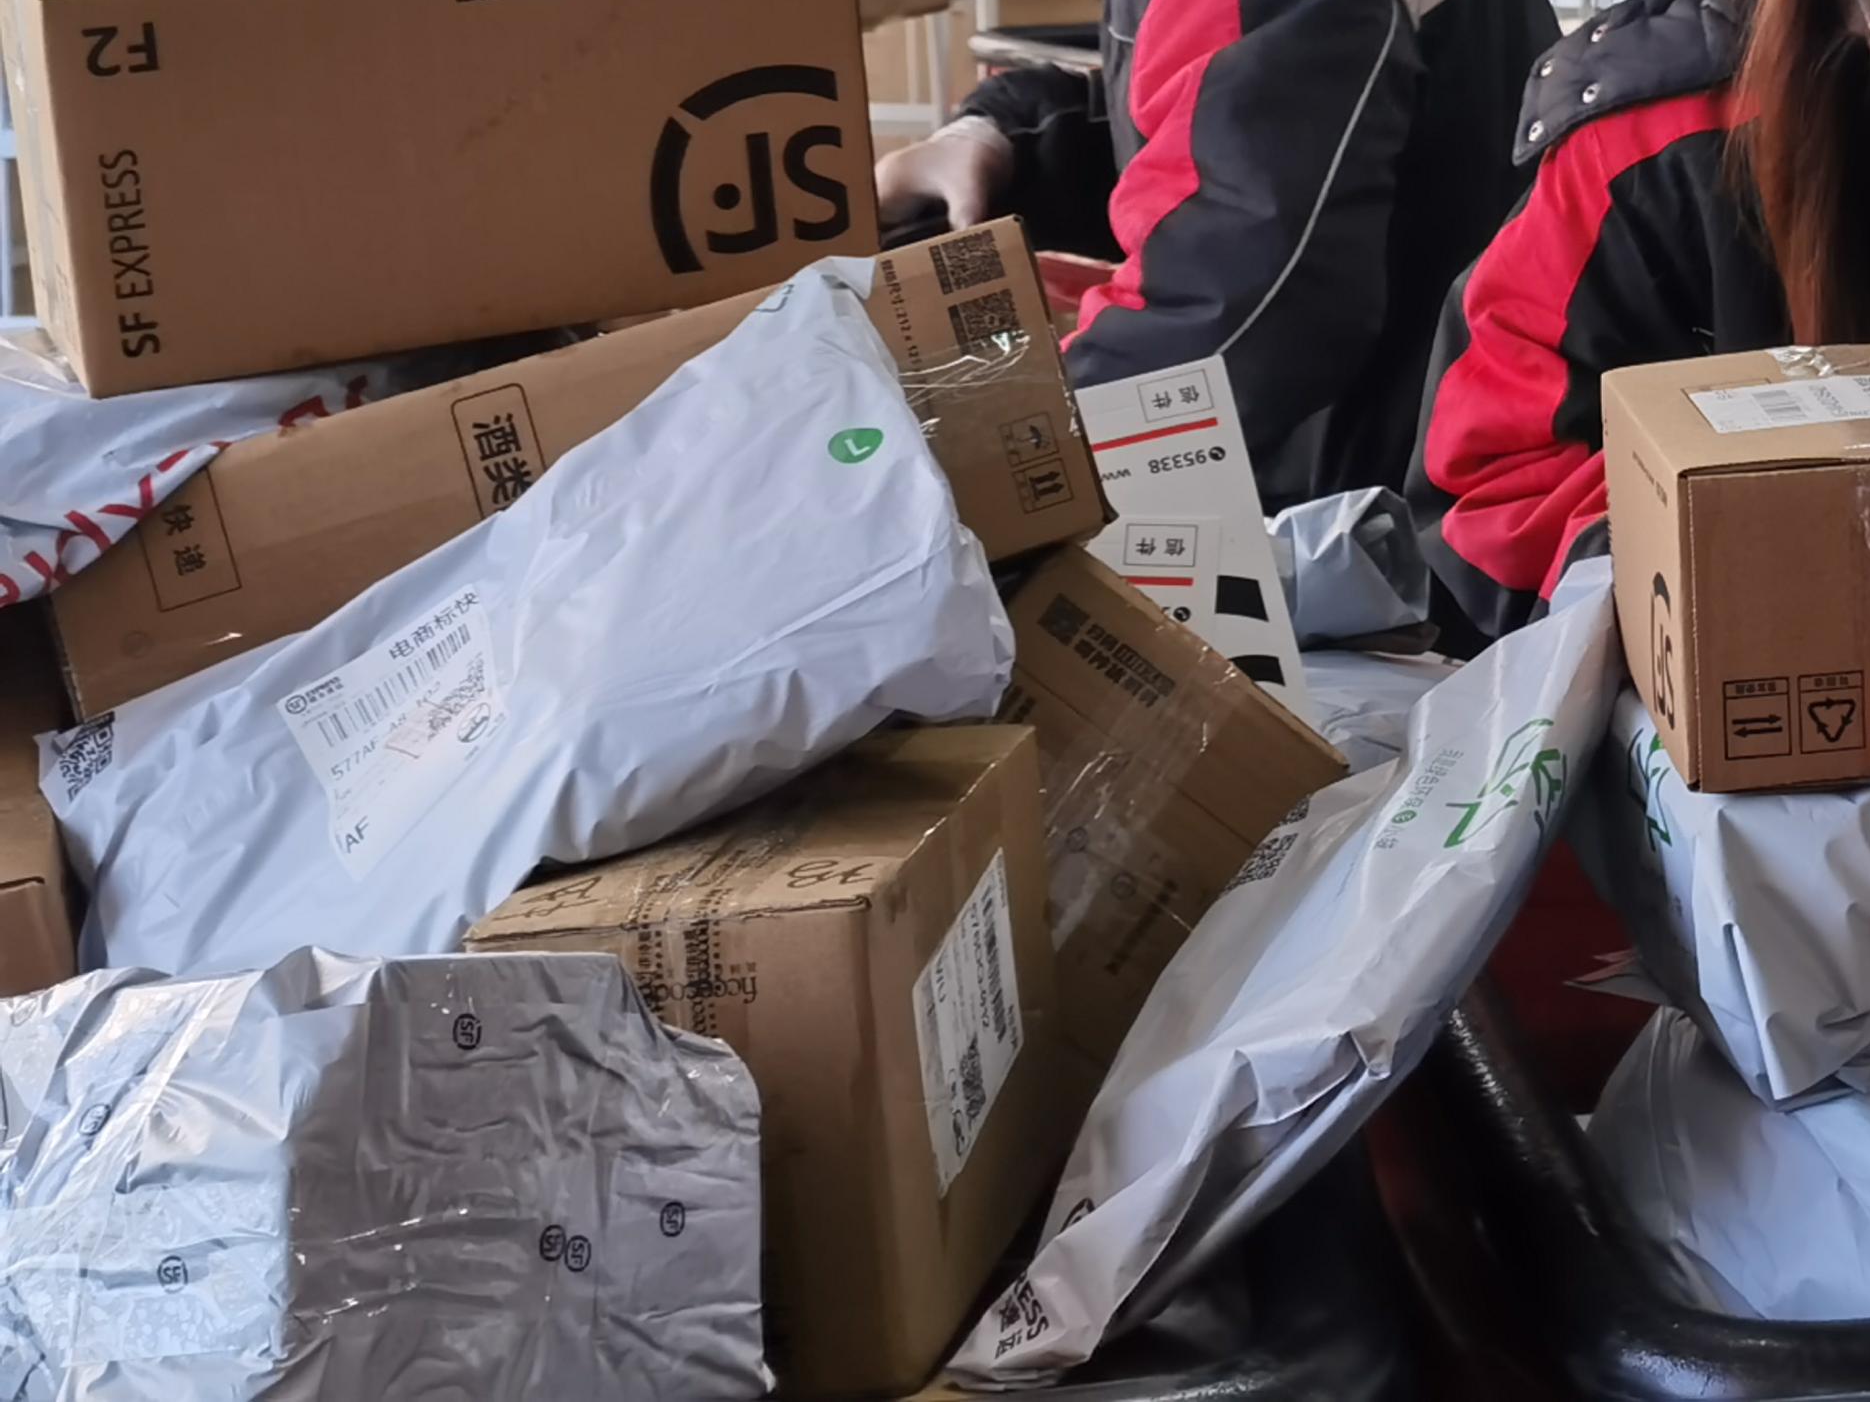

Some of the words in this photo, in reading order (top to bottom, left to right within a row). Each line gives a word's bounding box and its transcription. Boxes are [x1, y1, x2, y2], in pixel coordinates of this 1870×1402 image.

[82, 22, 160, 78] F2
[98, 149, 153, 300] EXPRESS
[123, 310, 161, 358] SF
[1151, 382, 1200, 409] 信件
[1148, 449, 1207, 474] 95338
[160, 503, 207, 577] 快递
[1136, 537, 1185, 557] 信件
